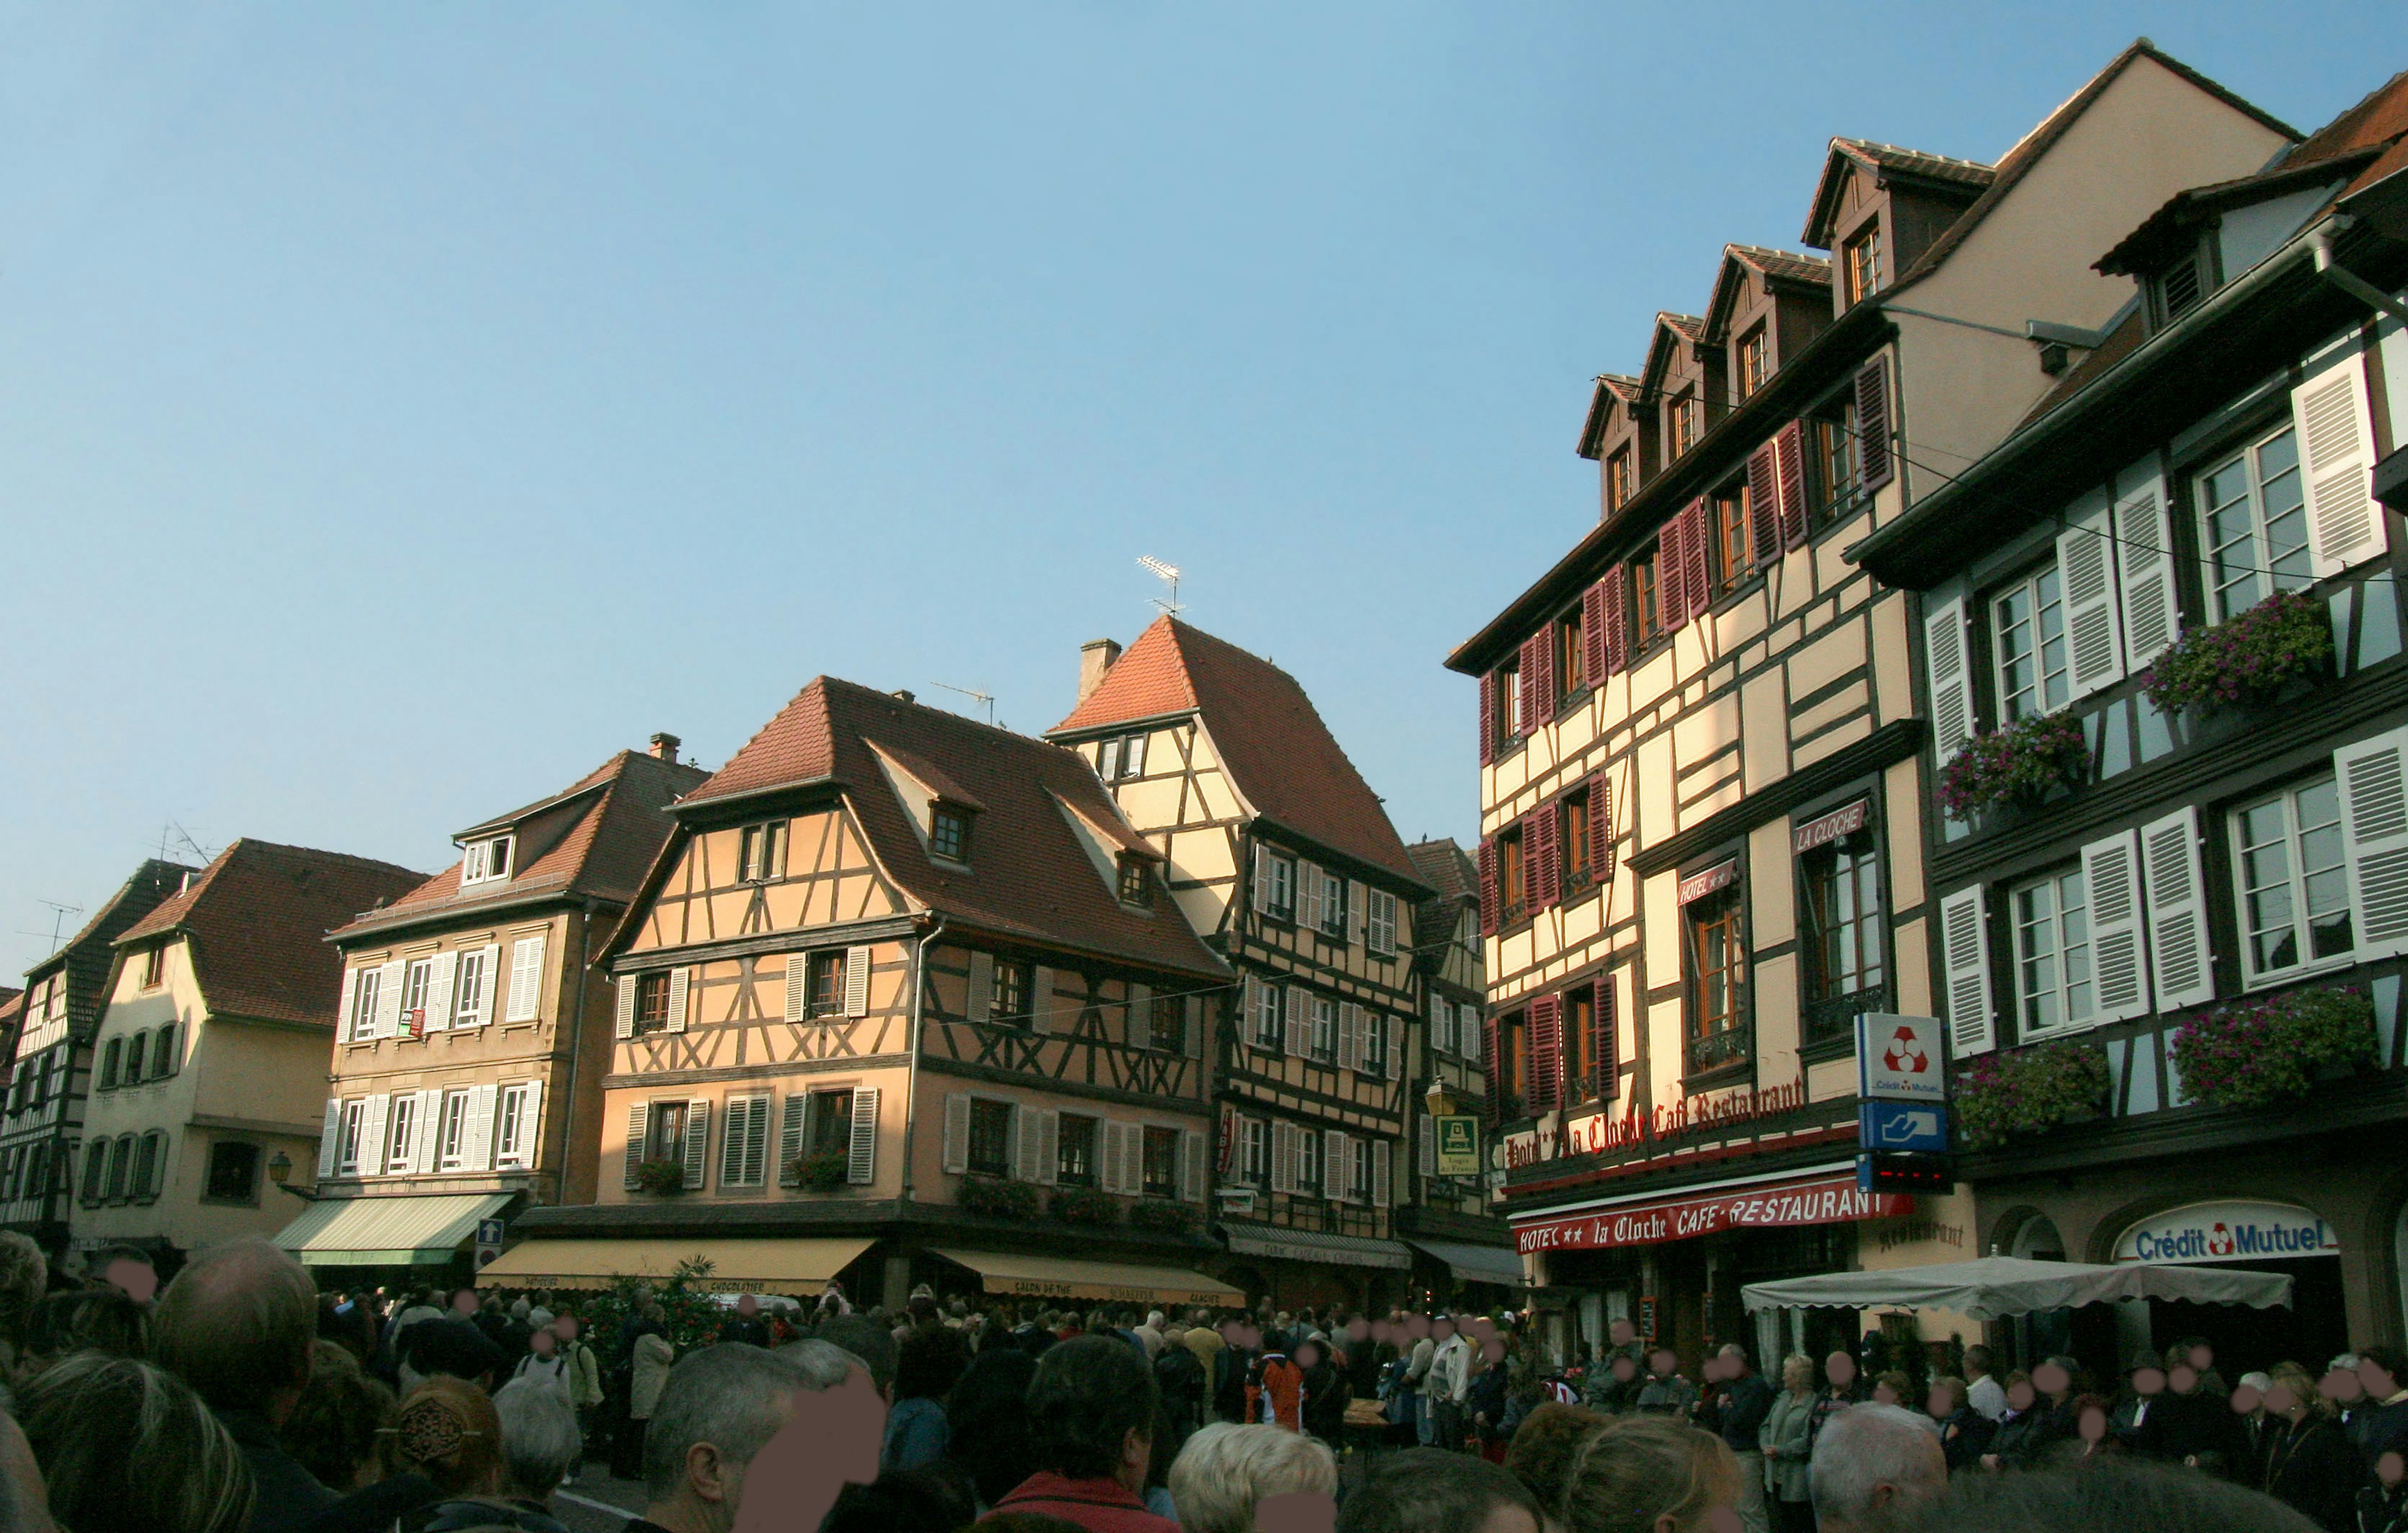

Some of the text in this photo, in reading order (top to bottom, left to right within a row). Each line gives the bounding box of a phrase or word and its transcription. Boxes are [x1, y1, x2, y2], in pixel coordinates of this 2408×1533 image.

[1797, 808, 1859, 851] LA CLOCHE
[1680, 881, 1707, 903] HOTEL
[1589, 1107, 1647, 1154] Cloche
[1694, 1073, 1805, 1132] Restaurant
[1520, 1226, 1559, 1252] HOTEL
[1594, 1221, 1609, 1244] la
[1614, 1214, 1666, 1242] Cloche
[2136, 1219, 2324, 1261] Crédit Mutuel
[710, 1282, 764, 1292] CHOCOLATIER
[1015, 1282, 1040, 1293] SALON
